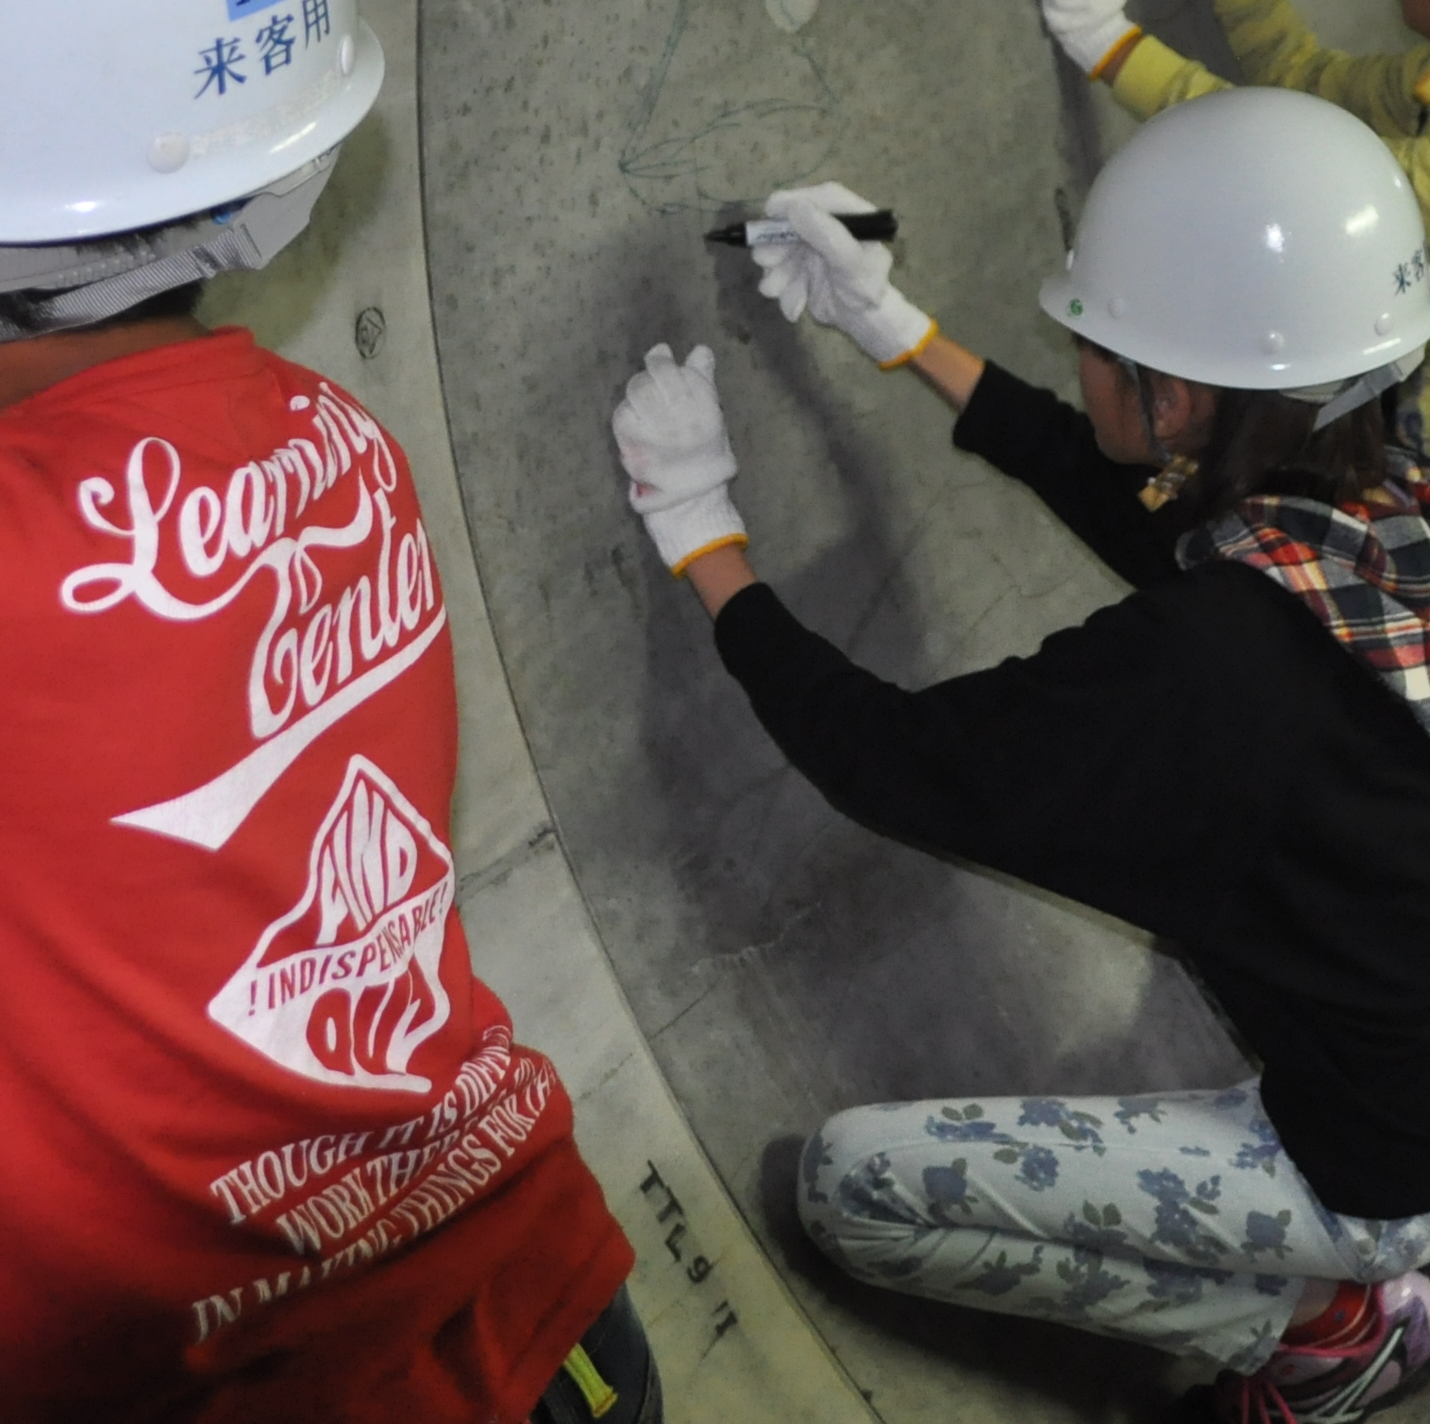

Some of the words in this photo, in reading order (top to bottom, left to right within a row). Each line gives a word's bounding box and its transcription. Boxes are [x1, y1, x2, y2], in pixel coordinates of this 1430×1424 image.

[1392, 240, 1428, 296] 来客
[60, 382, 397, 621] Learning
[248, 476, 435, 739] Center
[315, 778, 418, 946] AND
[192, 1287, 244, 1343] IN
[389, 1133, 502, 1238] THINGS
[477, 1092, 527, 1157] FOR
[209, 1129, 374, 1224] THOUGH
[374, 1115, 425, 1149] IT
[426, 1089, 459, 1138] IS
[275, 1167, 375, 1255] WORK
